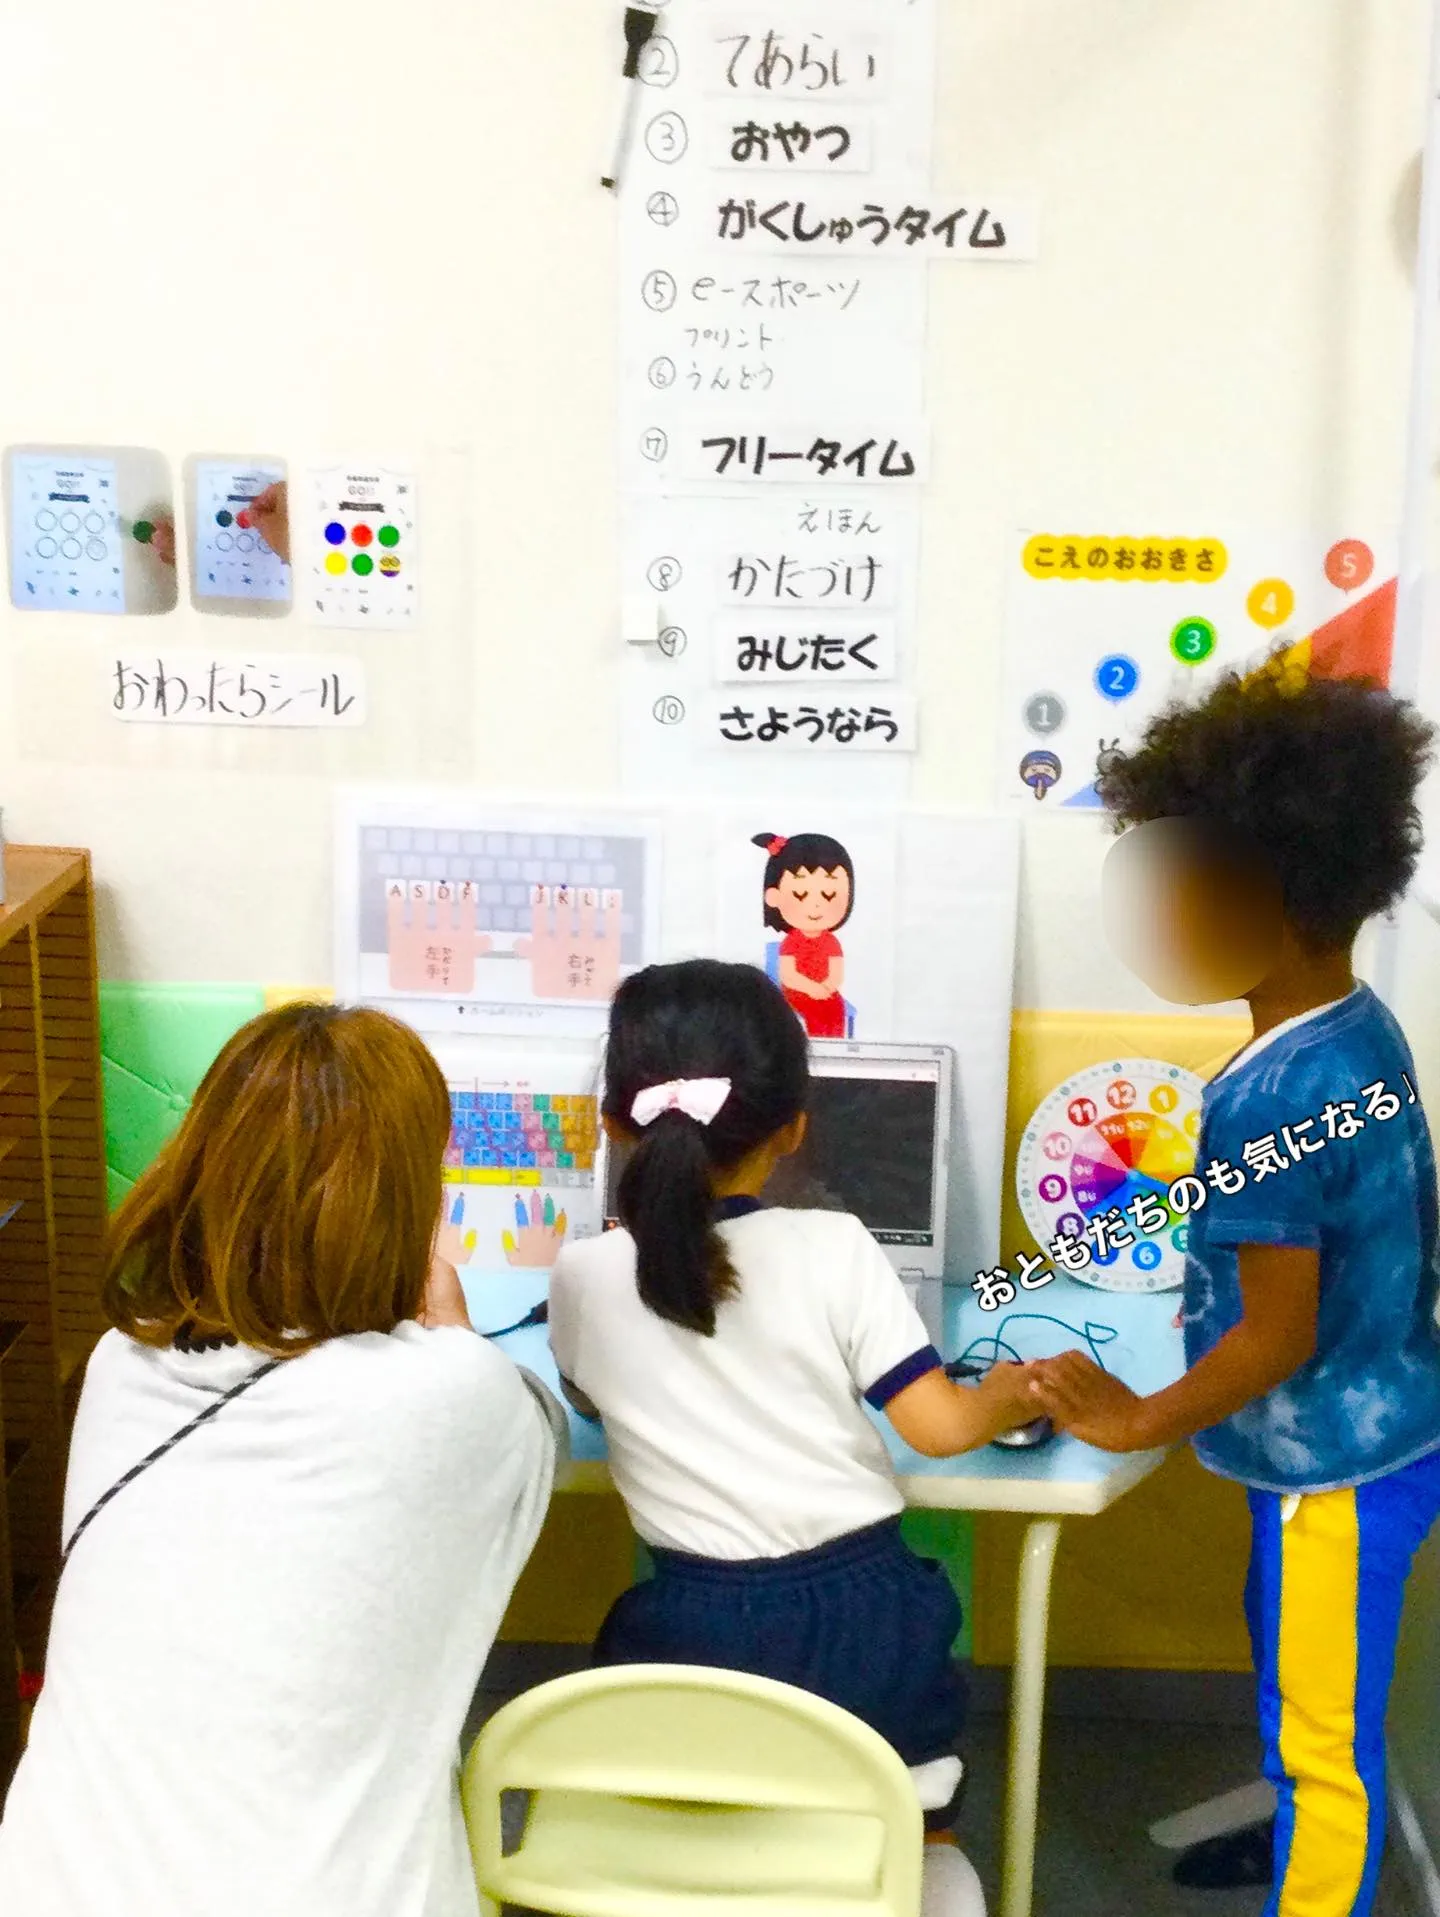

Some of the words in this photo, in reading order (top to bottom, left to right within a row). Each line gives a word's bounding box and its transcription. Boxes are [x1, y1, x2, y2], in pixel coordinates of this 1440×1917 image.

[714, 28, 876, 91] てあらい
[730, 120, 852, 163] おやつ
[718, 198, 1007, 249] がくしゅうタイム
[685, 322, 774, 351] プリント
[686, 361, 775, 391] うんどう
[701, 436, 916, 477] フリータイム
[797, 503, 882, 535] えほん
[1033, 545, 1216, 573] こえのおおきさ
[727, 554, 883, 602] かたづけ
[737, 633, 878, 672] みじたく
[112, 658, 356, 718] おわったらシール
[720, 705, 899, 744] さようなら
[389, 884, 402, 897] A
[413, 884, 424, 898] S
[1070, 1101, 1095, 1123] 11
[1107, 1084, 1136, 1106] 12
[1043, 1136, 1072, 1157] 10
